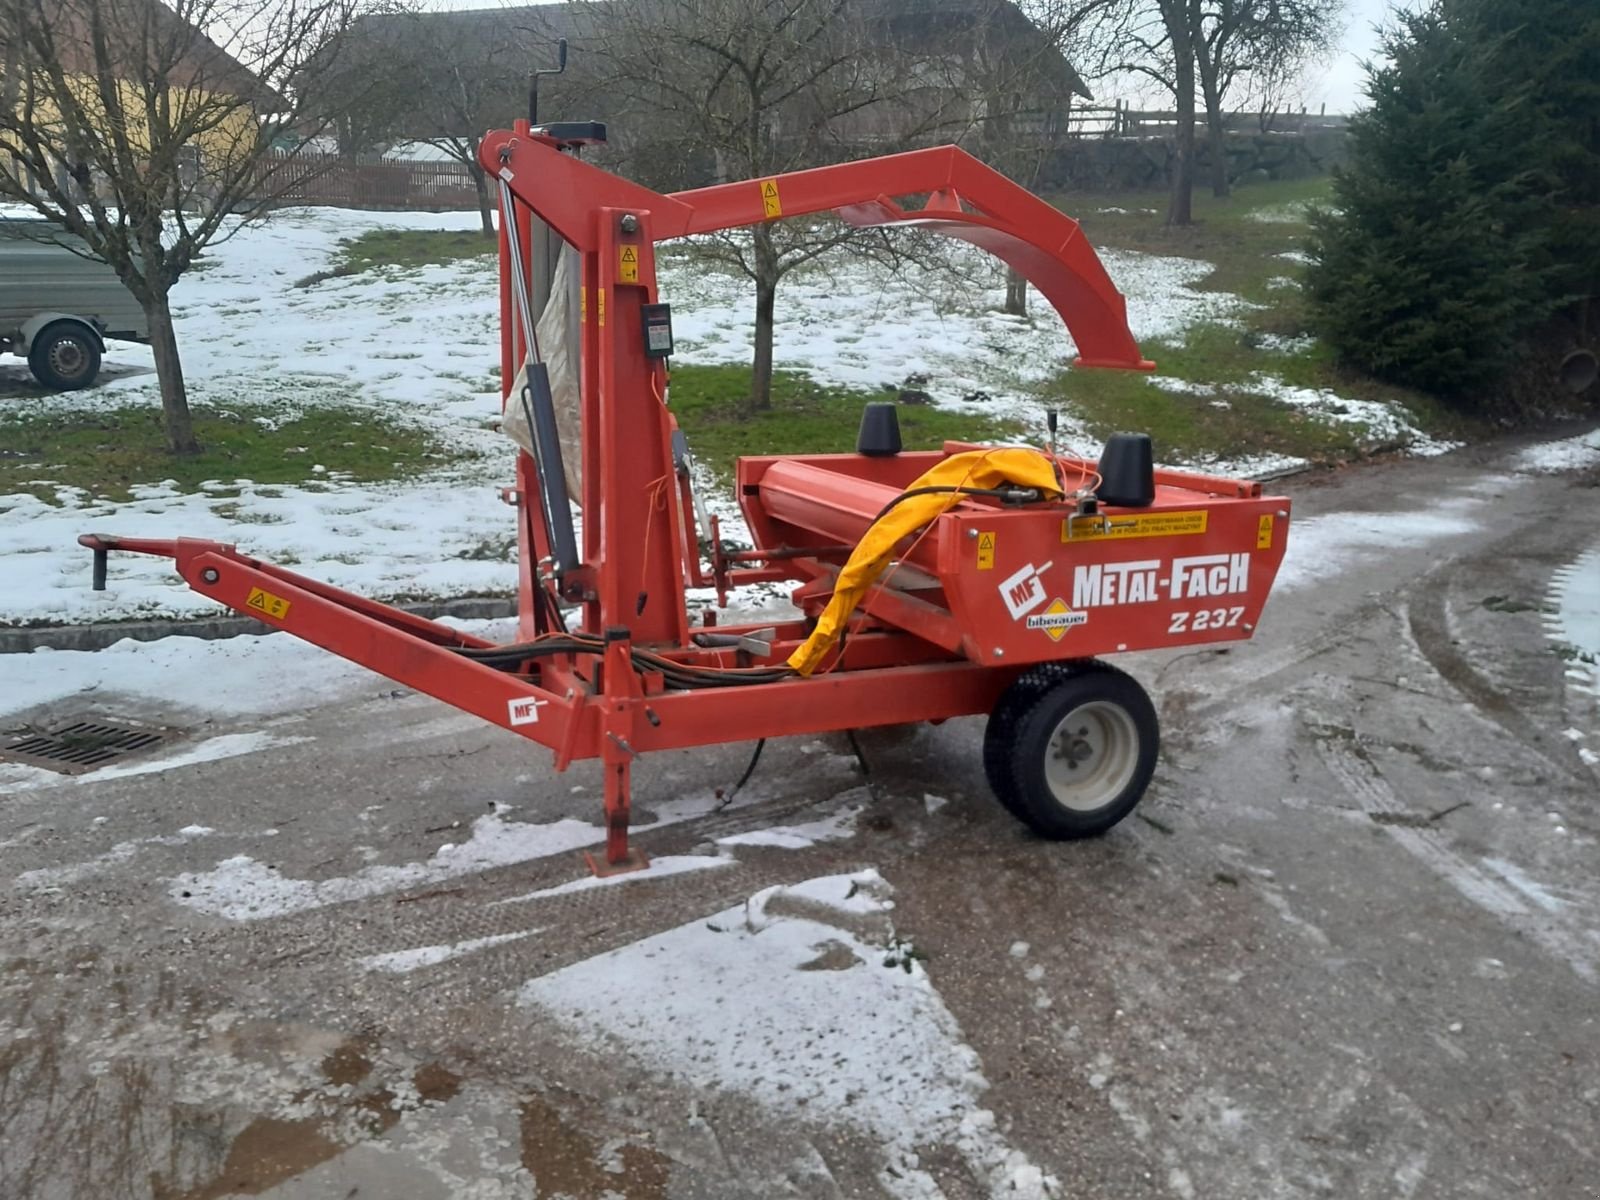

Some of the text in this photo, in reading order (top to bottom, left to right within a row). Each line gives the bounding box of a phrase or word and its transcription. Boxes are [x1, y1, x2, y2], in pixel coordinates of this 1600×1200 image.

[1008, 573, 1036, 609] MF
[1072, 552, 1250, 608] METAL-FACH
[1027, 615, 1086, 628] biberauer
[1167, 606, 1246, 633] Z 237
[514, 703, 535, 719] MF
